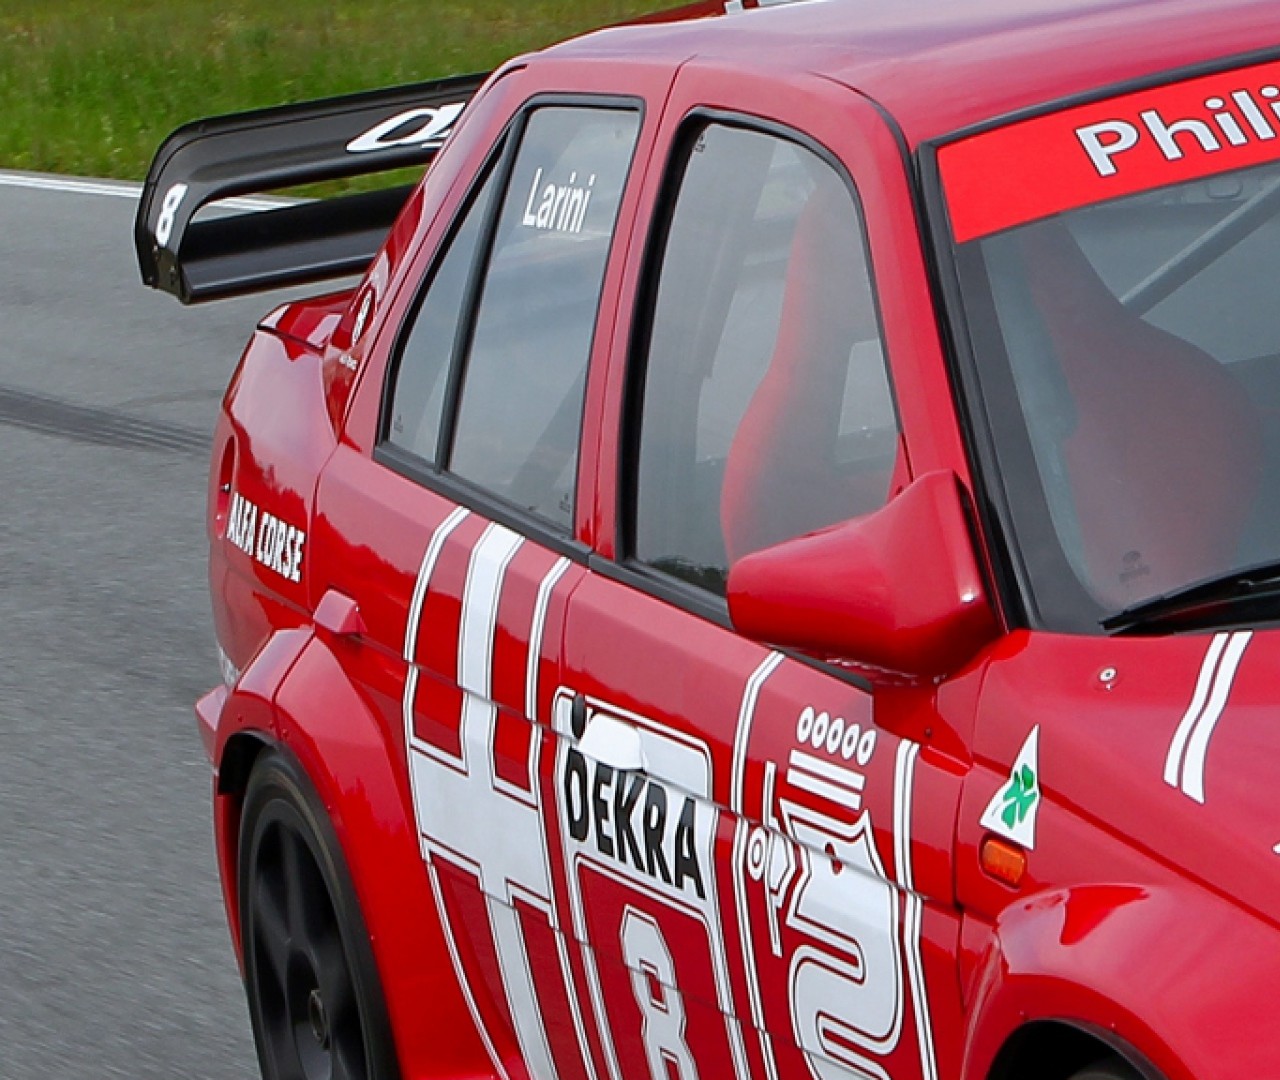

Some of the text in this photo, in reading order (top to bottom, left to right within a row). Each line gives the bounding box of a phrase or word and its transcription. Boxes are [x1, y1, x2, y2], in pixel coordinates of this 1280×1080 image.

[155, 183, 188, 248] 8
[522, 161, 596, 233] Larini
[226, 492, 305, 583] ALFA CORSE
[564, 746, 708, 901] DEKRA
